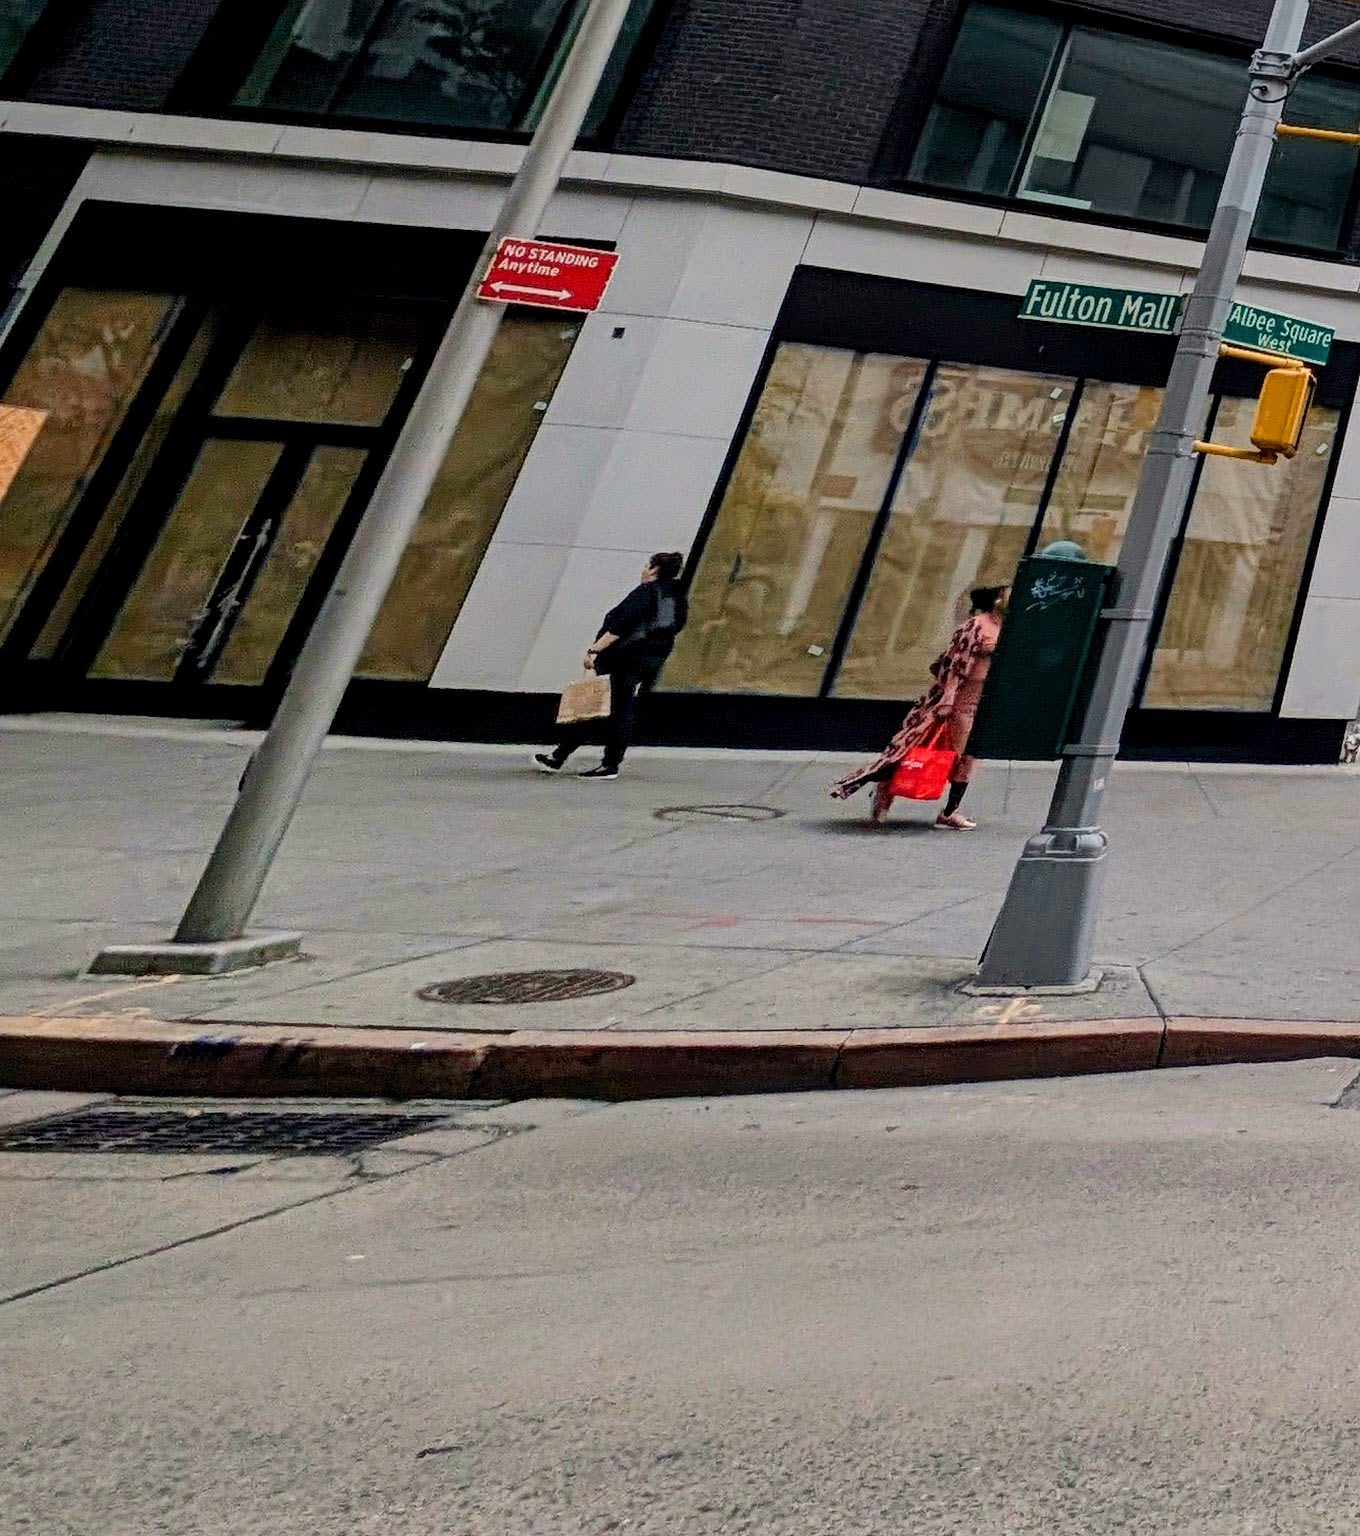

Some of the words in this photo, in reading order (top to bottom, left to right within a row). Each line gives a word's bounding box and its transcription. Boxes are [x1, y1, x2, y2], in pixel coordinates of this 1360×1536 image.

[498, 258, 560, 277] Anytime
[503, 244, 526, 257] NO
[528, 247, 599, 268] STANDING
[1025, 284, 1112, 324] Fulton
[1118, 294, 1176, 330] Mall
[1230, 305, 1276, 332] Albee
[1280, 319, 1332, 347] Square
[1257, 332, 1292, 354] West
